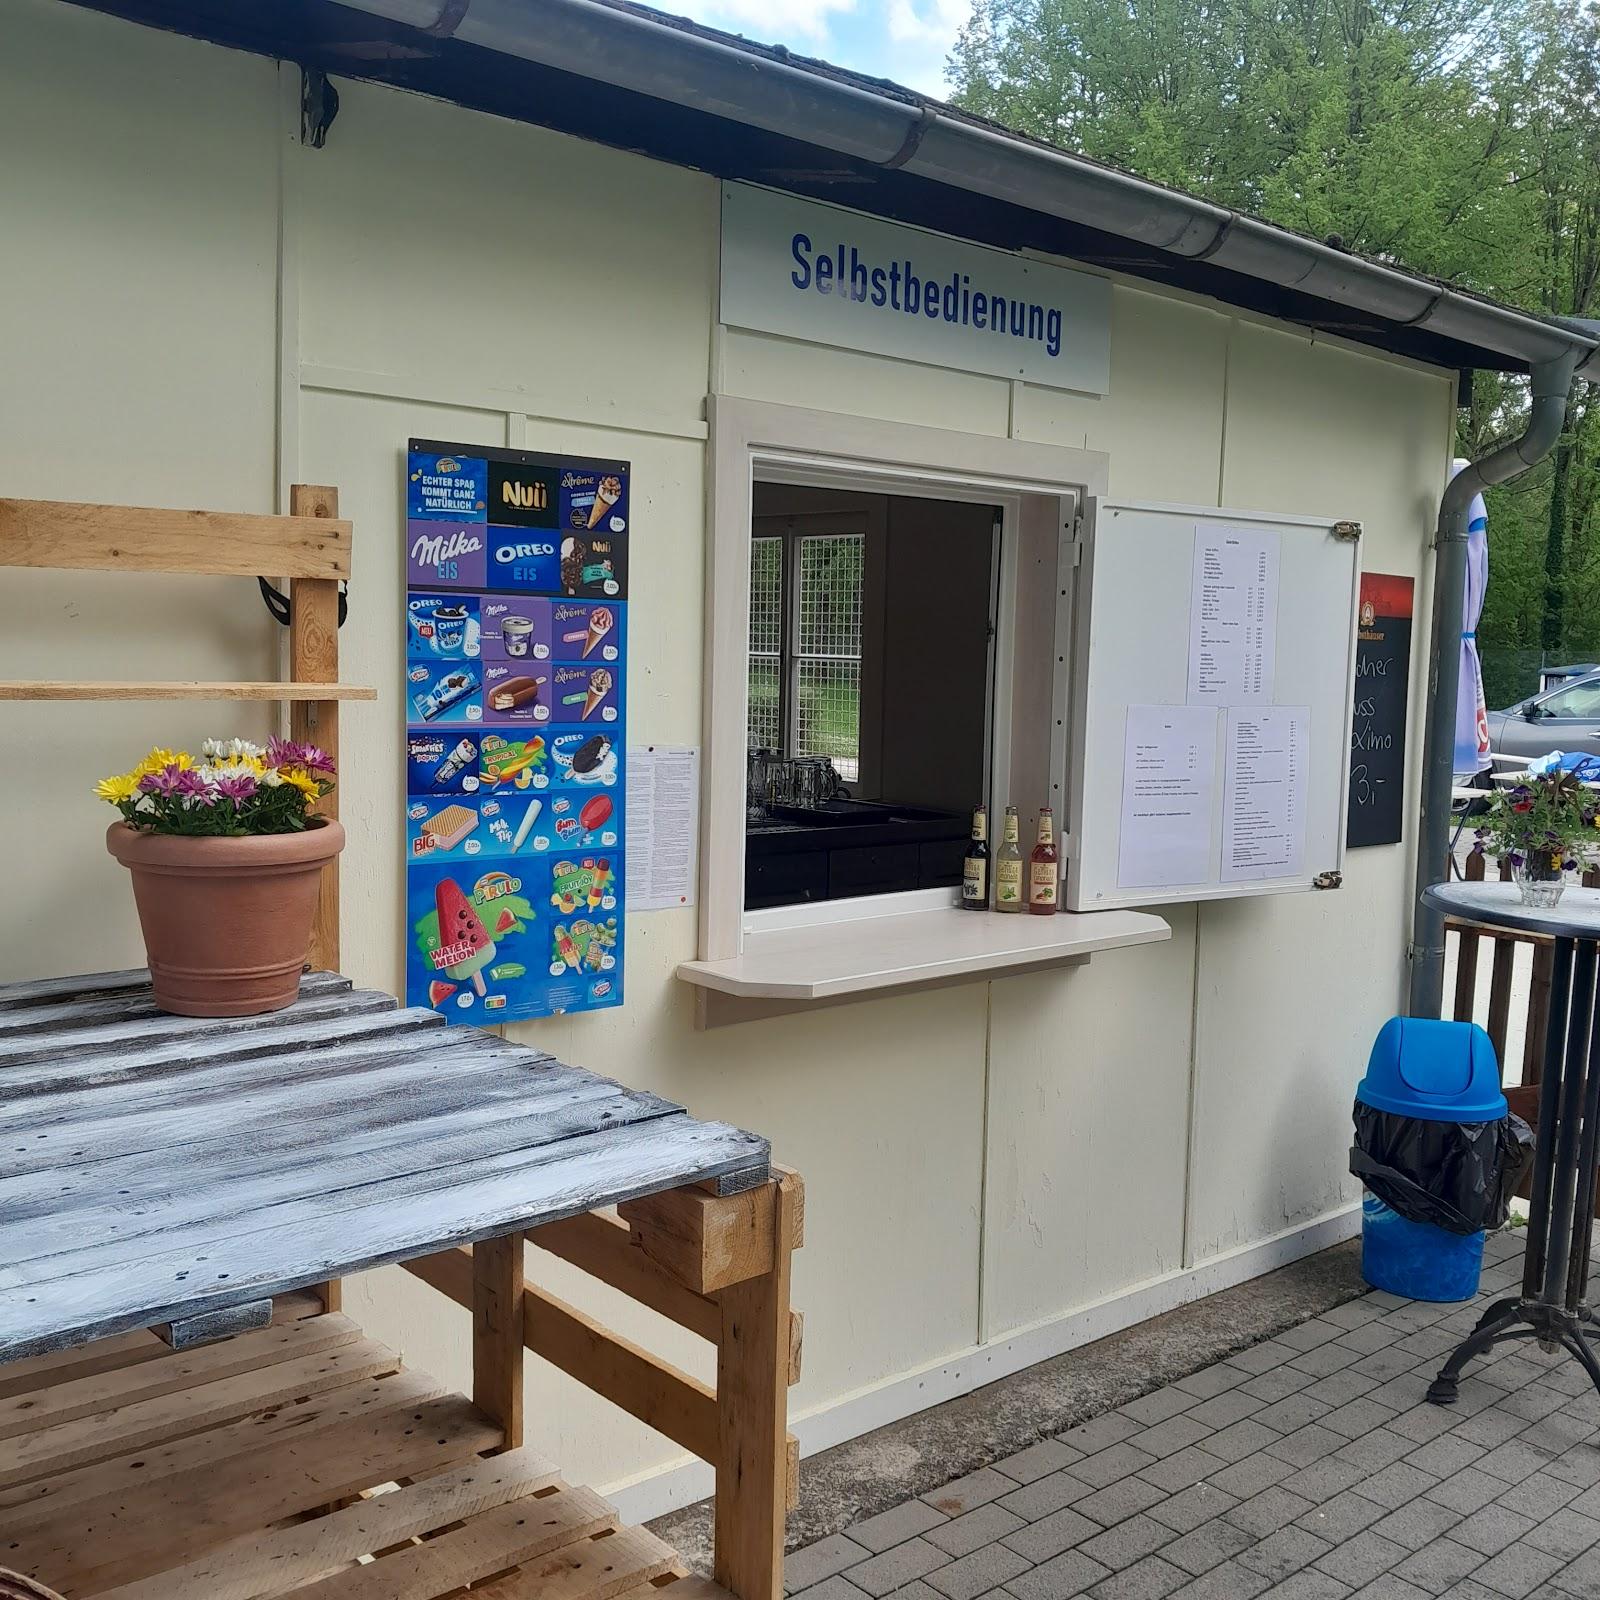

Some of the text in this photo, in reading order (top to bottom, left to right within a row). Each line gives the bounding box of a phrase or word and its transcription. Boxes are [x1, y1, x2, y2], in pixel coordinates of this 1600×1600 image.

[791, 233, 1062, 357] Selbstbedienung
[422, 475, 453, 487] ECHTER
[421, 486, 475, 500] KOMMT GANZ
[425, 496, 472, 510] NATÜRLICH
[411, 531, 483, 567] Milka
[495, 543, 554, 563] OREO
[437, 561, 458, 580] EIS
[513, 567, 537, 581] EIS
[409, 599, 443, 610] OREO
[485, 604, 509, 616] Milka
[438, 620, 464, 630] OREO
[486, 666, 509, 678] Milka
[554, 733, 584, 746] OREO
[414, 834, 435, 852] BIG
[430, 940, 469, 960] WATER
[435, 947, 477, 969] MELON
